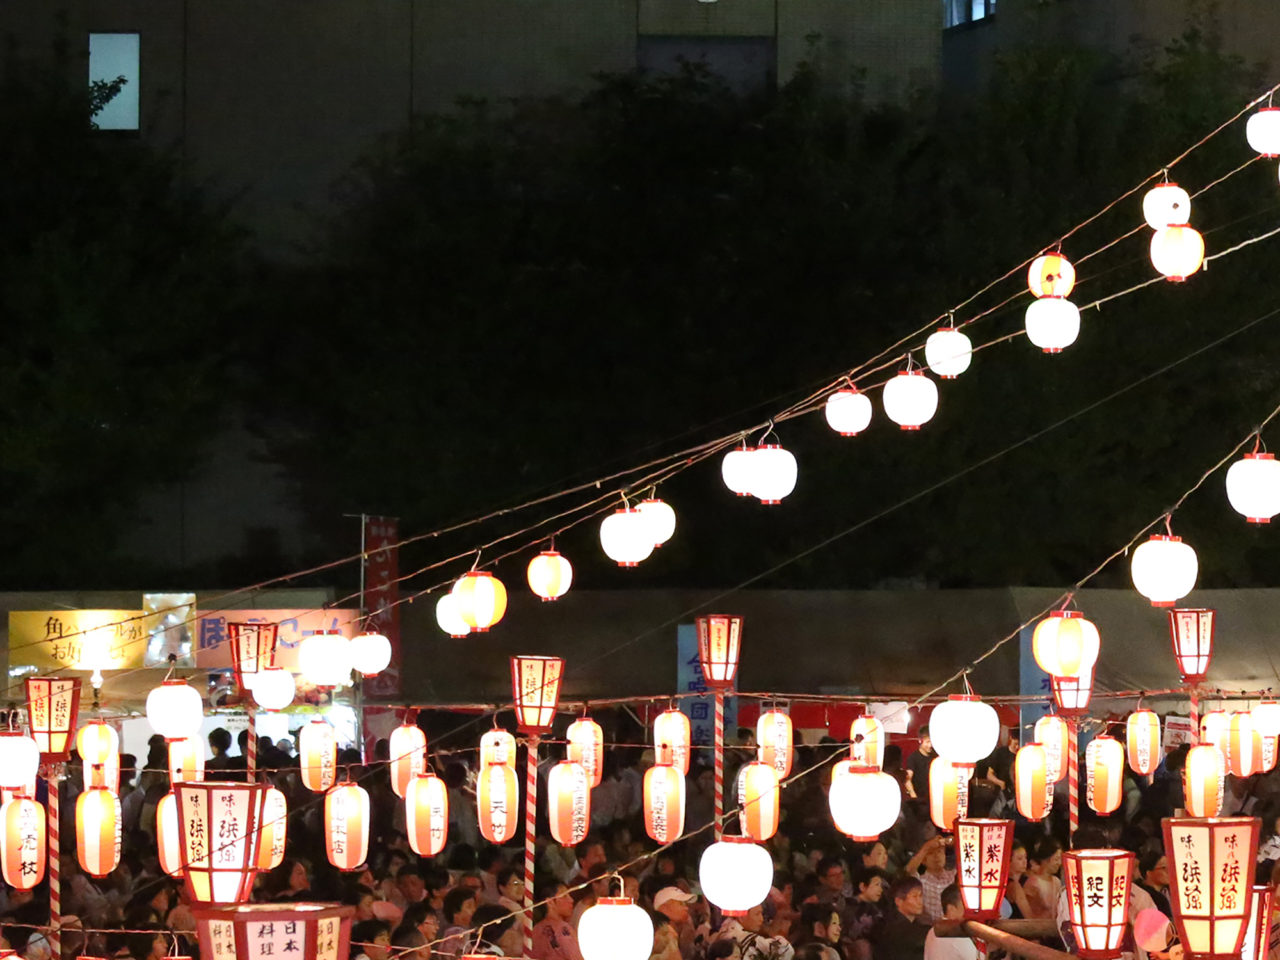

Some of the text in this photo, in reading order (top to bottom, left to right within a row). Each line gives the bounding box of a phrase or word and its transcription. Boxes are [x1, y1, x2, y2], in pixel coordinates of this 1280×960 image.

[1086, 876, 1105, 908] 紀文
[1112, 875, 1126, 908] 紀文
[256, 922, 276, 956] 料理
[283, 920, 301, 954] 日本
